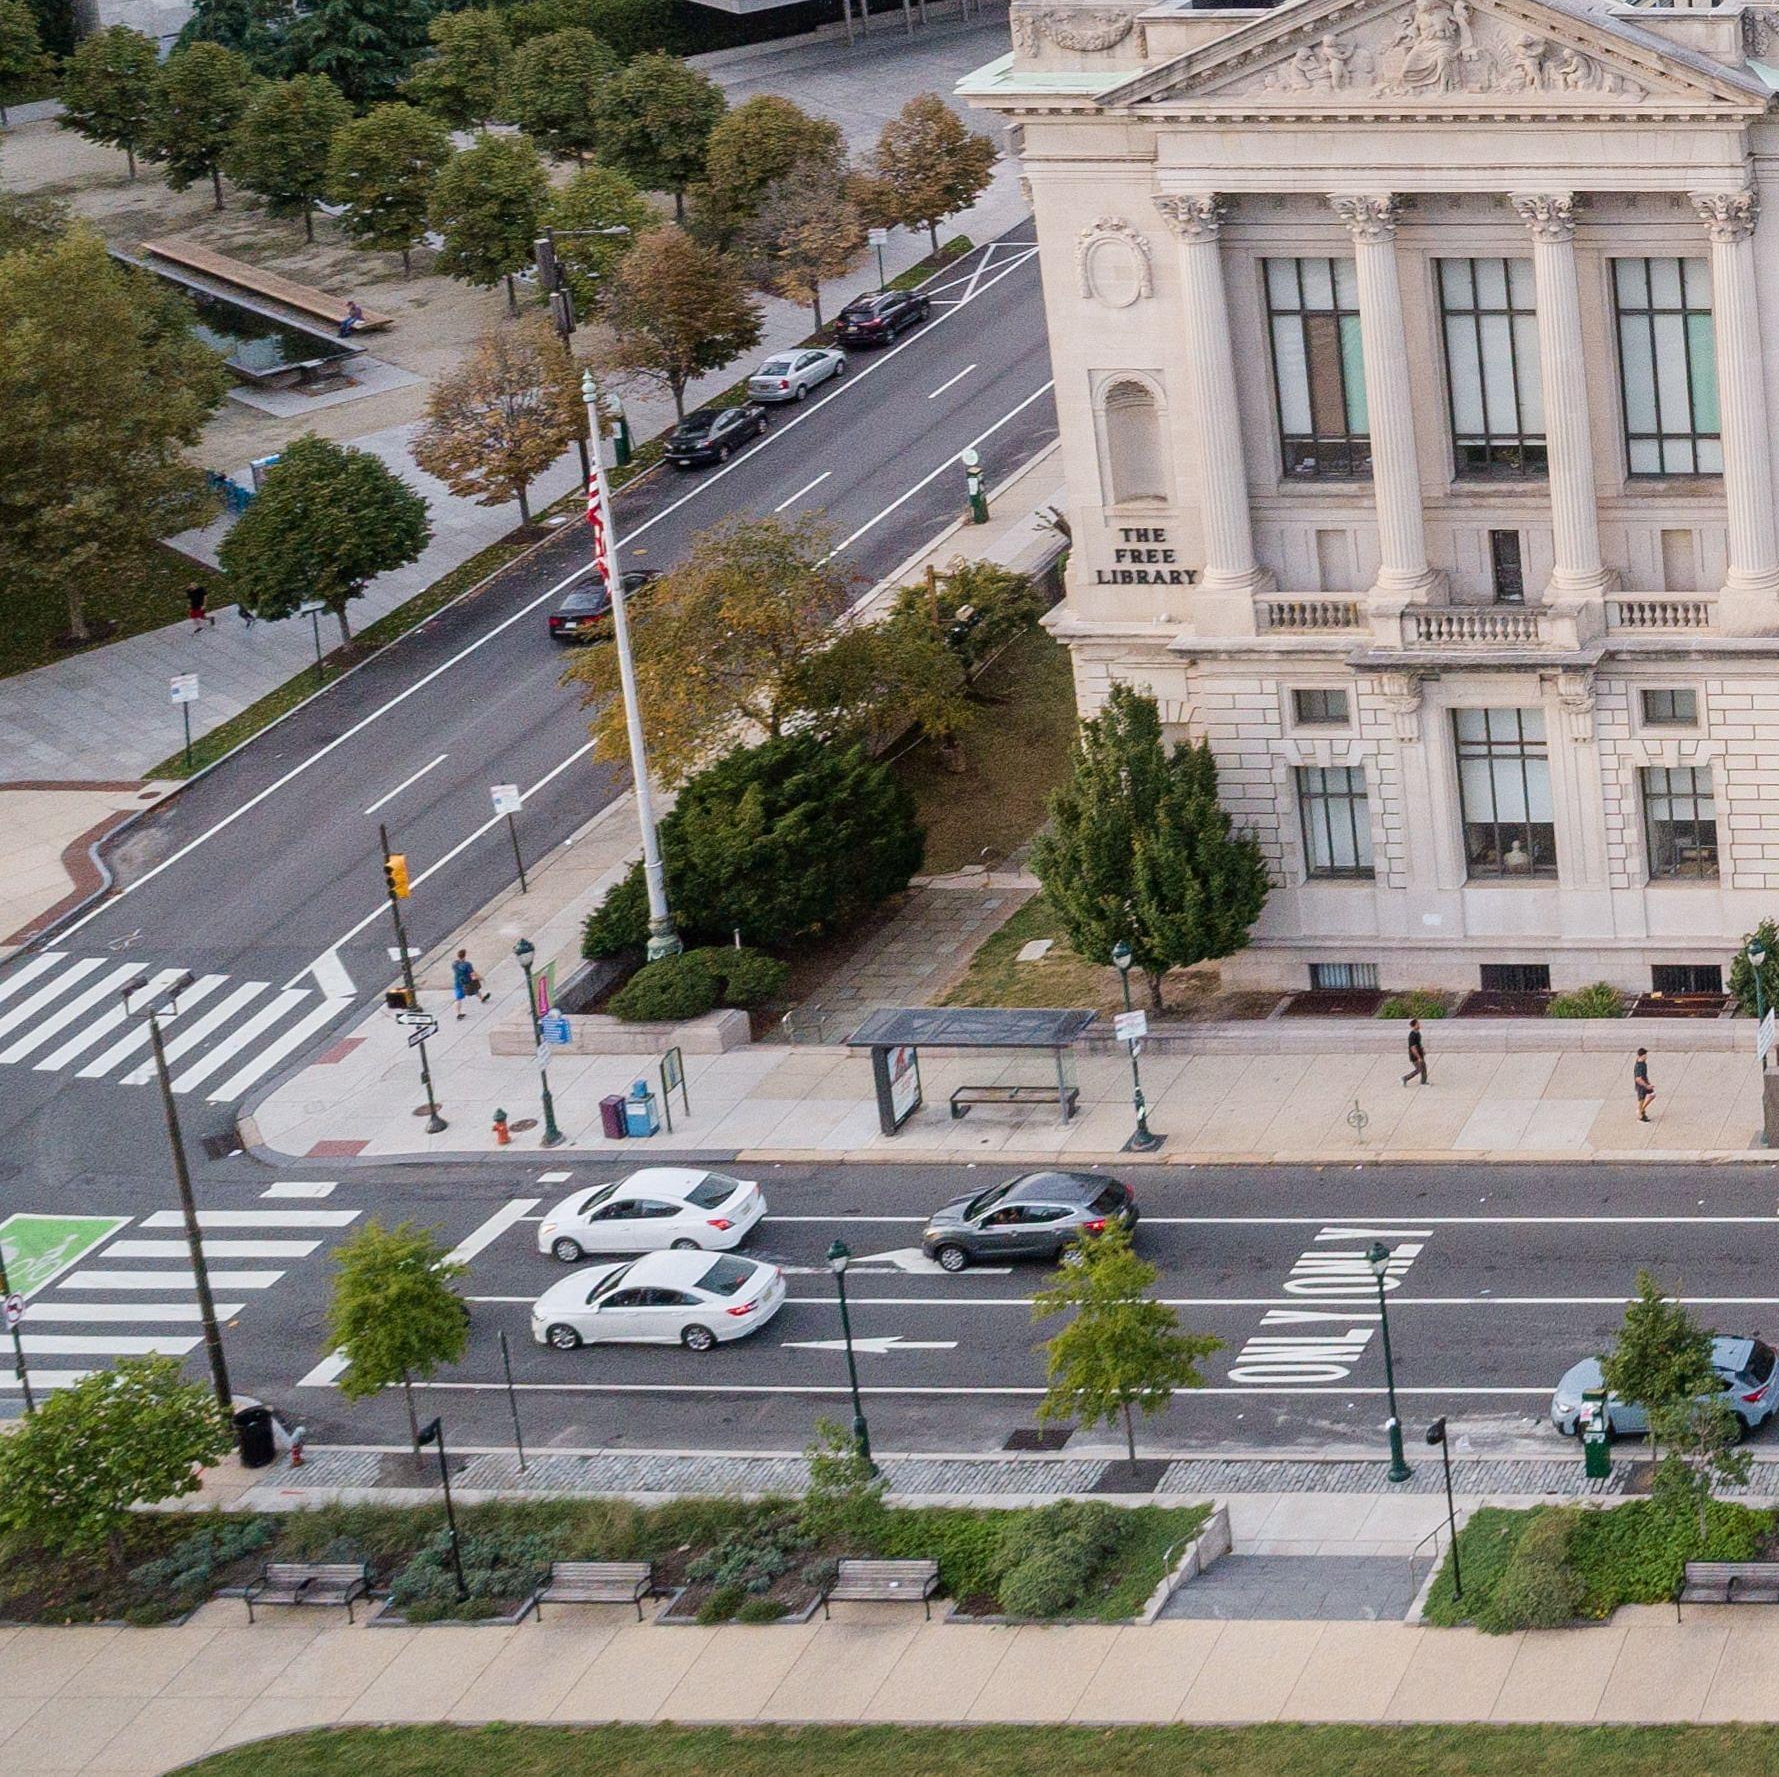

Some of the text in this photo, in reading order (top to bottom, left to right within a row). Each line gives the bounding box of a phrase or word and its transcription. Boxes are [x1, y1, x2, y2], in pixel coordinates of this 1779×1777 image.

[1118, 527, 1167, 543] THE
[1114, 548, 1176, 564] FREE
[1095, 569, 1199, 585] LIBRARY
[1282, 1226, 1434, 1295] ONLY
[1227, 1309, 1383, 1384] ONLY
